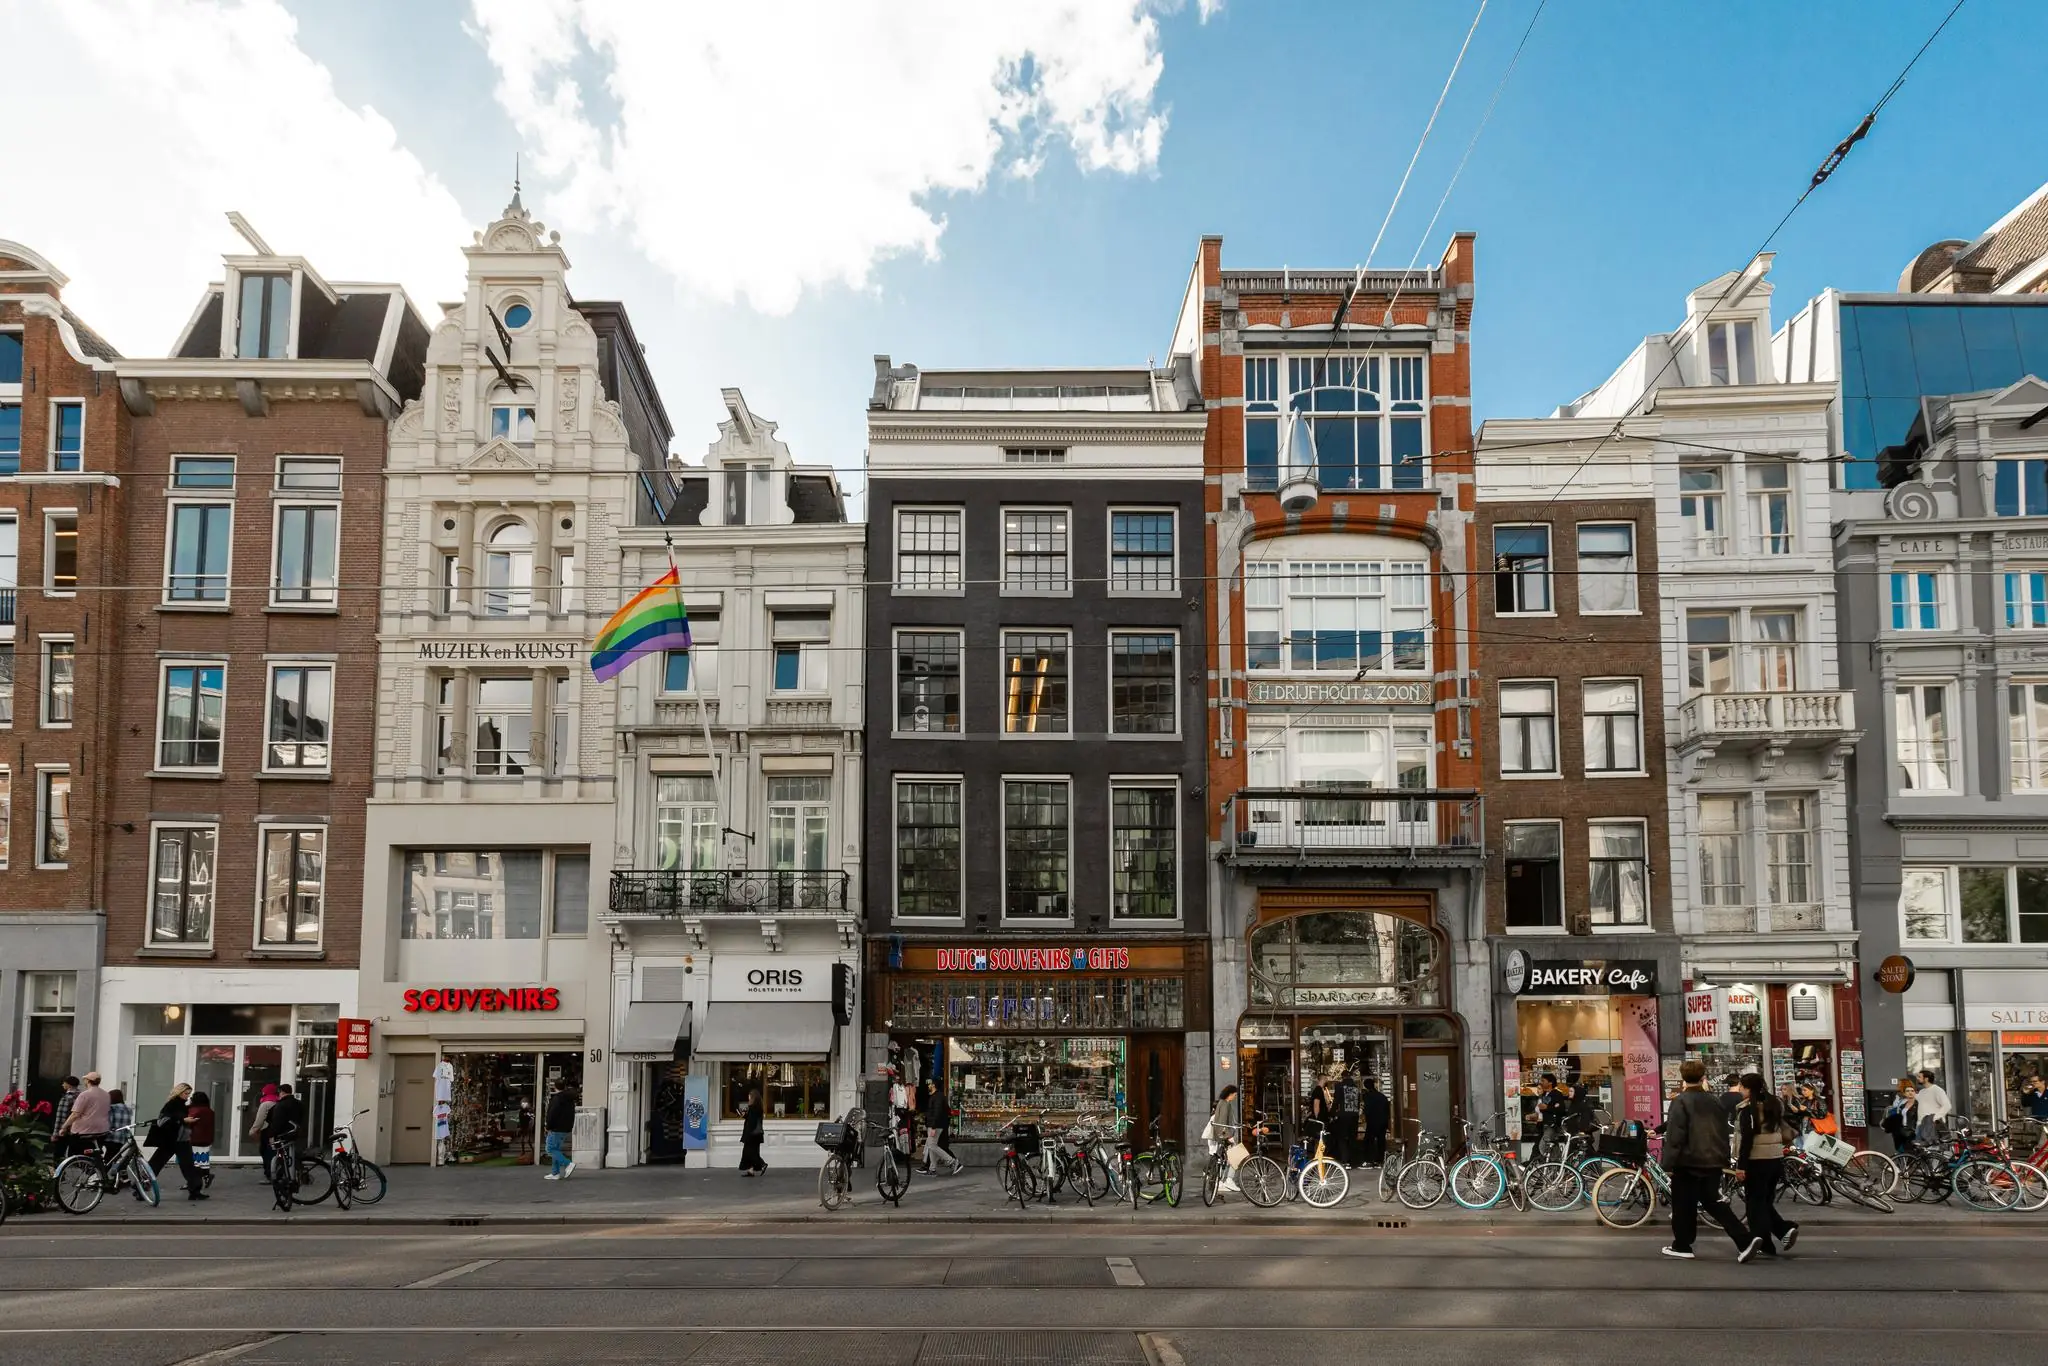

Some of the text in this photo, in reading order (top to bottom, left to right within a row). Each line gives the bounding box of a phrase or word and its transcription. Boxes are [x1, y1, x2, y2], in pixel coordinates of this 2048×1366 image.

[1900, 540, 1943, 553] CAFE
[418, 642, 578, 659] MUZIEK en KUNST
[1376, 685, 1420, 700] ZOON
[937, 947, 1129, 970] DUTCH SOUVENIRS GIFTS
[747, 969, 803, 985] ORIS
[1531, 969, 1649, 990] BAKERY Cafe
[1881, 974, 1905, 983] STONE
[403, 988, 560, 1012] SOUVENIRS
[1687, 994, 1712, 1014] SUPER
[1991, 1011, 2035, 1023] SALT
[1216, 1037, 1235, 1048] 44
[590, 1049, 602, 1062] 50
[633, 1052, 657, 1060] ORIS
[748, 1052, 773, 1060] ORIS
[1536, 1057, 1568, 1066] BAKERY
